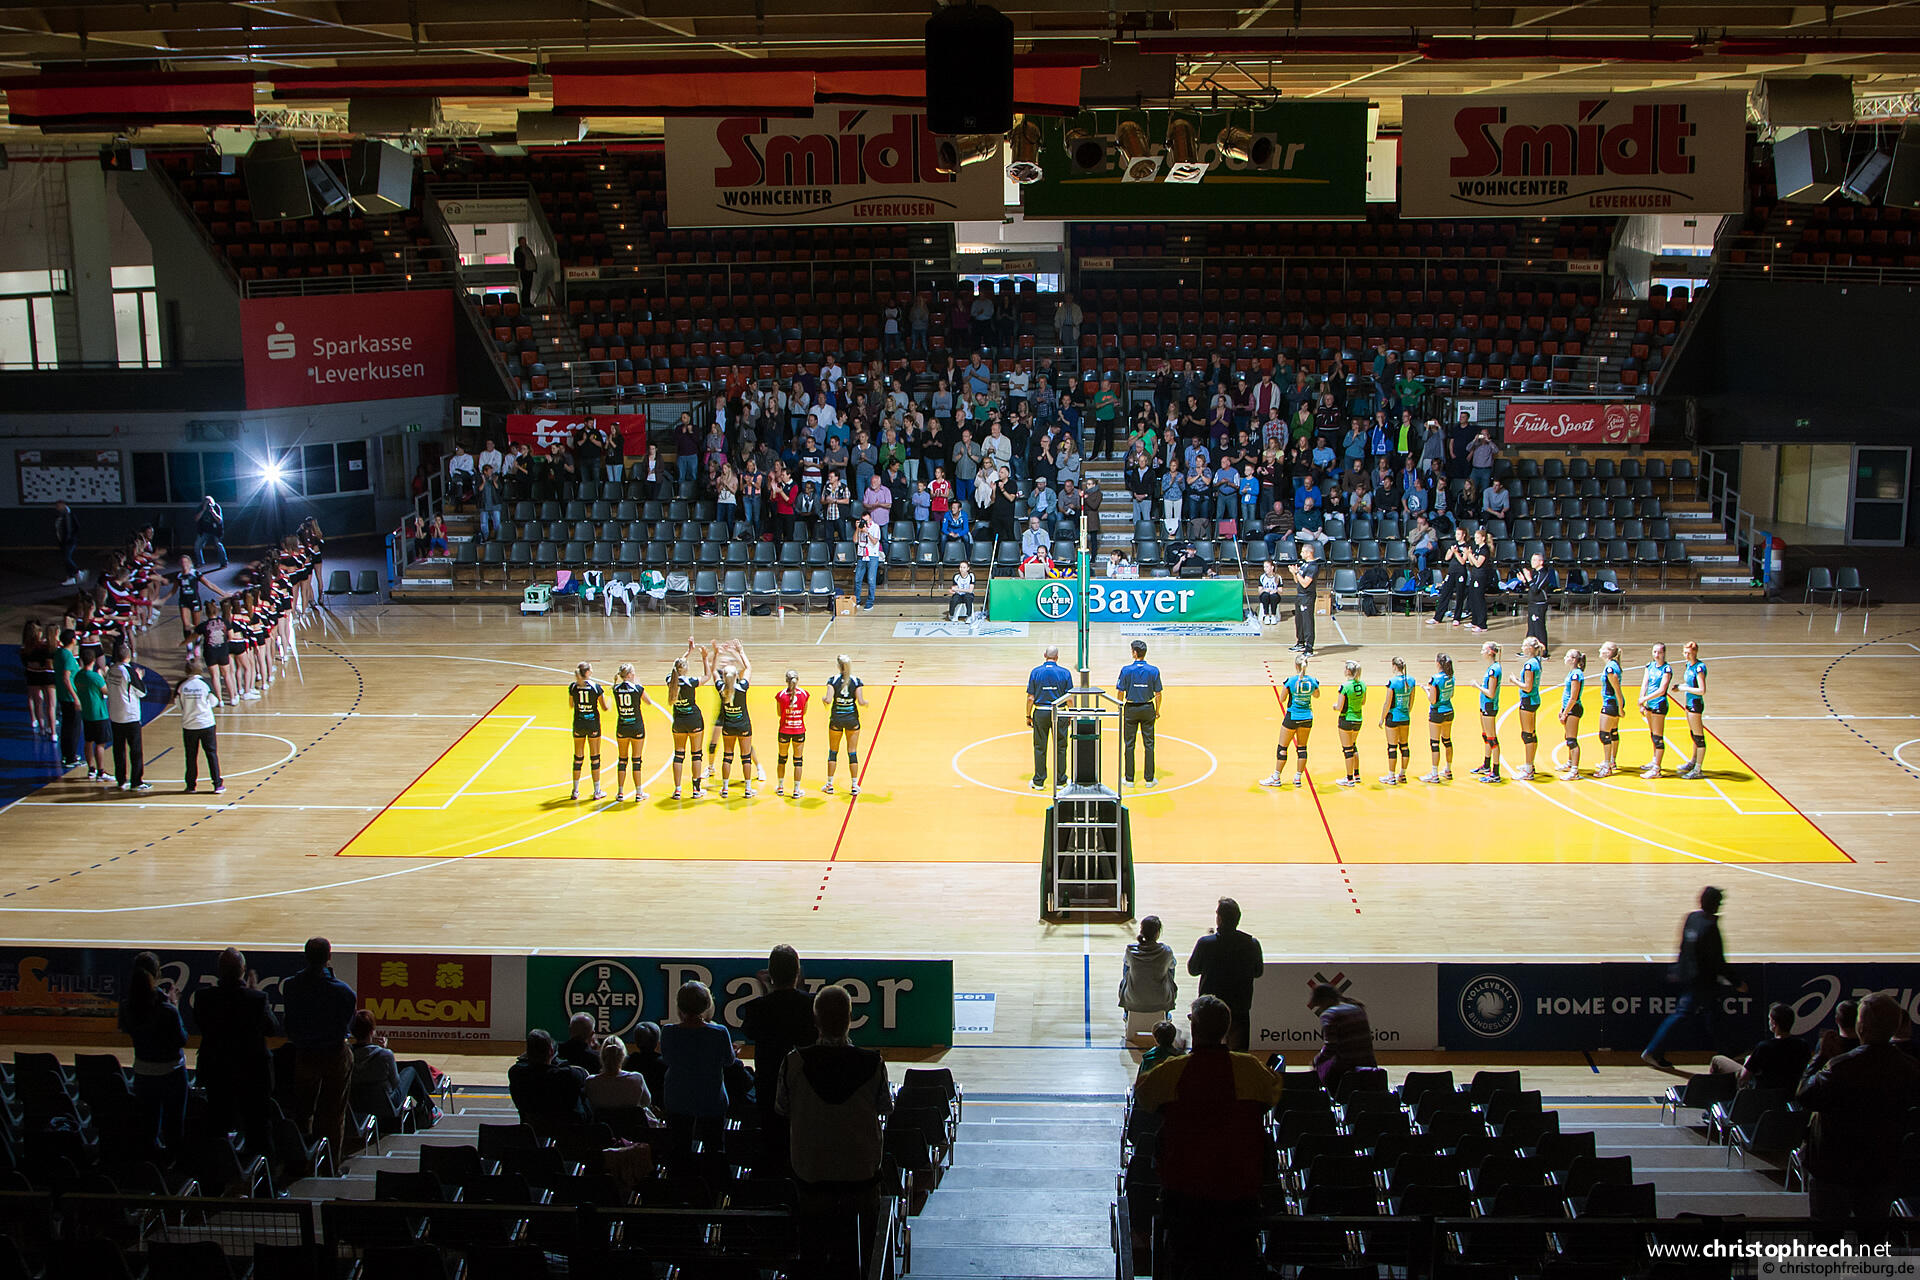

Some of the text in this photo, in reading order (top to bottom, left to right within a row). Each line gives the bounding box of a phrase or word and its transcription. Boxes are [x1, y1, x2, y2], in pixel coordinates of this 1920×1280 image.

[1450, 100, 1696, 177] Smidt
[1458, 180, 1568, 196] WOHNCENTER
[723, 190, 833, 206] WOHNCENTER
[1589, 195, 1672, 208] LEVERKUSEN
[853, 203, 935, 217] LEVERKUSEN
[313, 334, 413, 360] Sparkasse
[314, 362, 425, 384] Leverkusen
[1512, 412, 1595, 437] Früh Sport
[1088, 583, 1195, 620] Bayer
[840, 685, 849, 697] 4
[1295, 680, 1312, 694] 10
[1353, 683, 1363, 696] 9
[578, 690, 589, 703] 11
[618, 693, 632, 707] 10
[572, 992, 637, 1006] BAYER
[1466, 980, 1513, 1002] VOLLEYBALL
[364, 997, 486, 1023] MASON
[1536, 996, 1605, 1015] HOME
[1611, 996, 1643, 1015] OF
